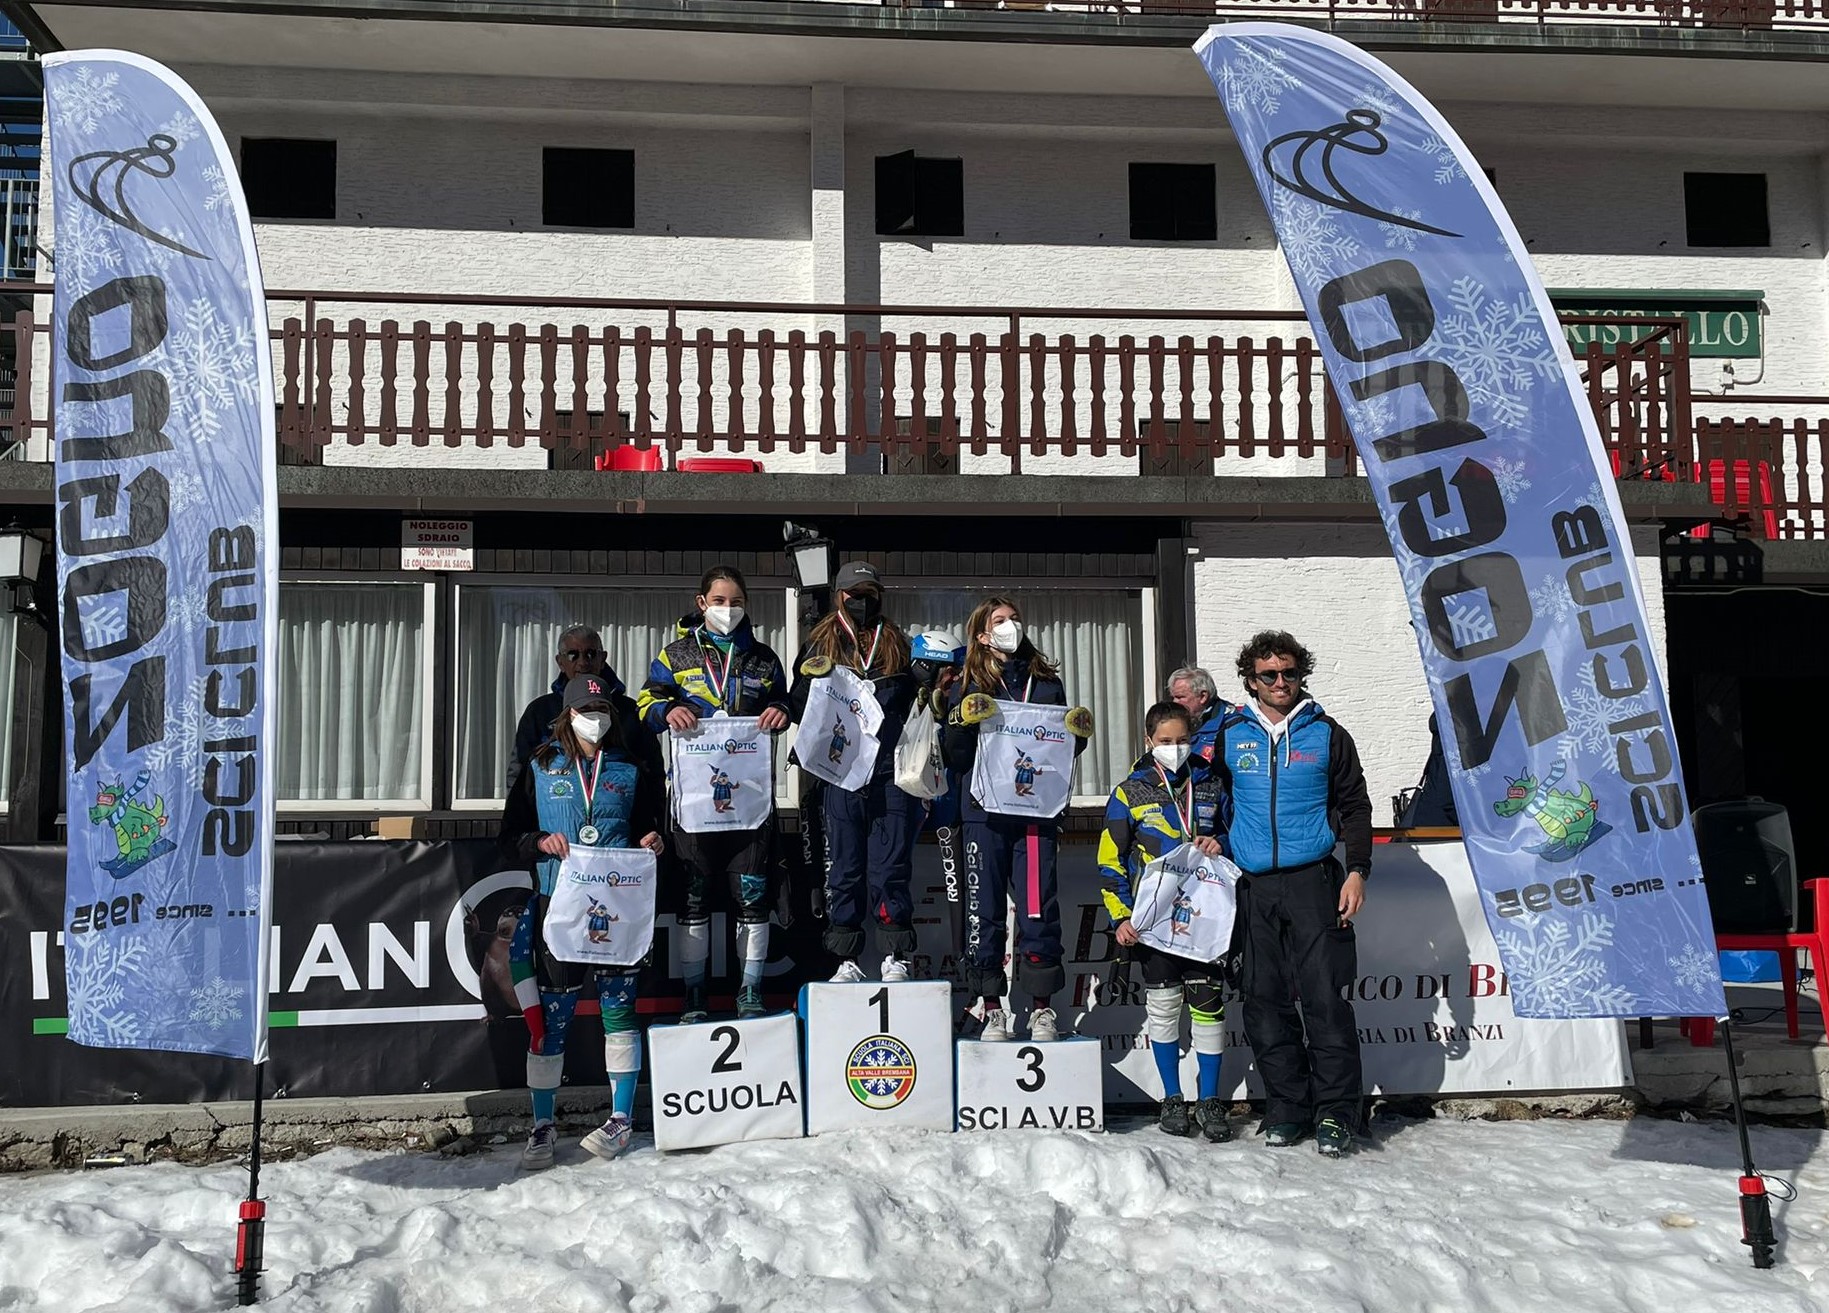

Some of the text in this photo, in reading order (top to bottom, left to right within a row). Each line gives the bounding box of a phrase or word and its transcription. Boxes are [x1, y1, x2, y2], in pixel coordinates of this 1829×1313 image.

[410, 522, 468, 530] NOLEGGIO
[418, 534, 460, 542] SDRAIO
[925, 651, 949, 659] HEAD
[1415, 974, 1452, 999] DI
[868, 986, 889, 1033] 1
[1393, 1027, 1415, 1043] DI
[1423, 1021, 1505, 1043] BRANZI
[710, 1025, 742, 1073] 2
[853, 1042, 873, 1063] SCUOLA
[876, 1040, 901, 1053] ITALIANA
[1015, 1046, 1046, 1092] 3
[662, 1080, 797, 1117] SCUOLA
[958, 1106, 1007, 1130] SCI
